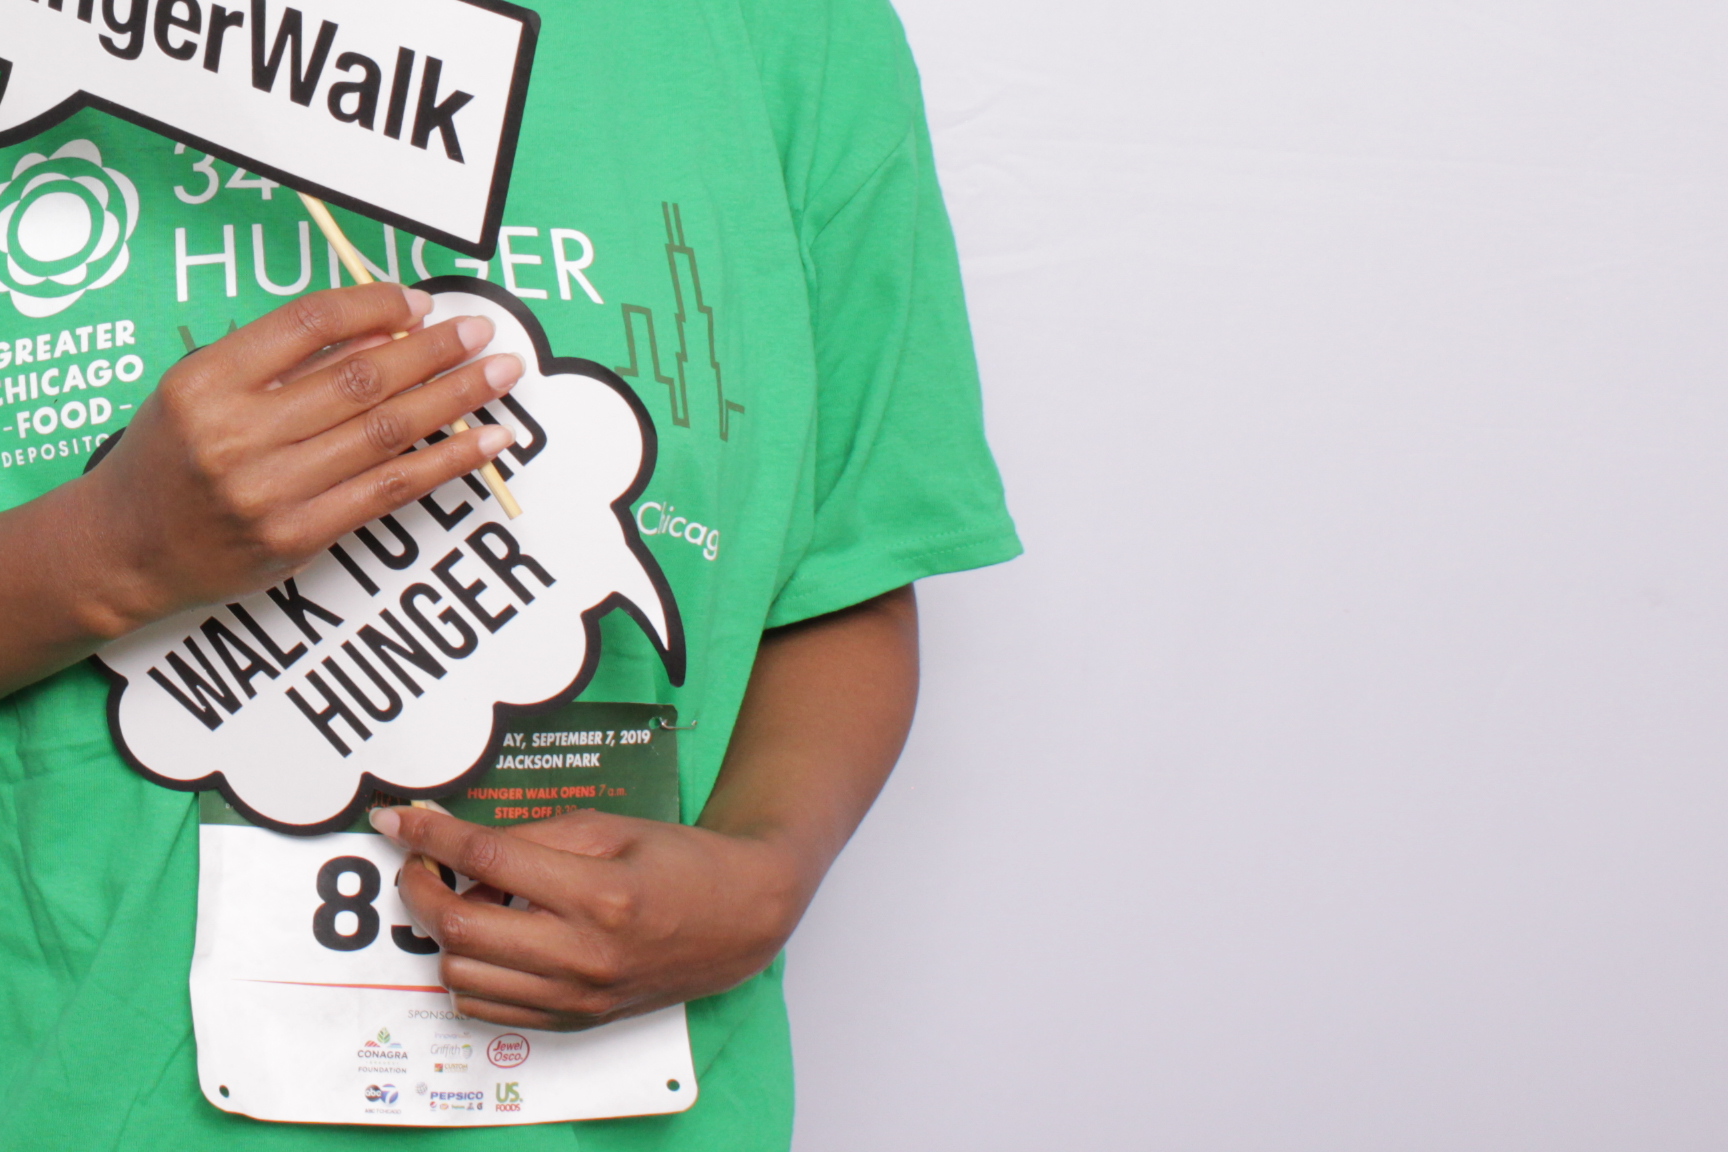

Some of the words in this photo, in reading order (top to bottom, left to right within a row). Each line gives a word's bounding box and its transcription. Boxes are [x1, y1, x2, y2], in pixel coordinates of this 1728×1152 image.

[175, 219, 605, 305] HUNGER
[285, 521, 557, 758] HUNGER
[146, 576, 345, 731] WALK
[532, 731, 603, 747] SEPTEMBER
[605, 731, 616, 747] 7,
[619, 730, 651, 744] 2019
[496, 754, 563, 769] JACKSON
[566, 753, 600, 767] PARK
[467, 787, 524, 800] HUNGER
[525, 787, 558, 799] WALK
[560, 786, 596, 798] OPENS
[494, 806, 529, 819] STEPS
[531, 806, 553, 818] OFF
[493, 1040, 523, 1051] Jewel
[357, 1050, 409, 1060] CONAGRA
[358, 1066, 407, 1074] FOUNDATION
[430, 1091, 484, 1101] PEPSICO
[495, 1103, 521, 1112] FOODS
